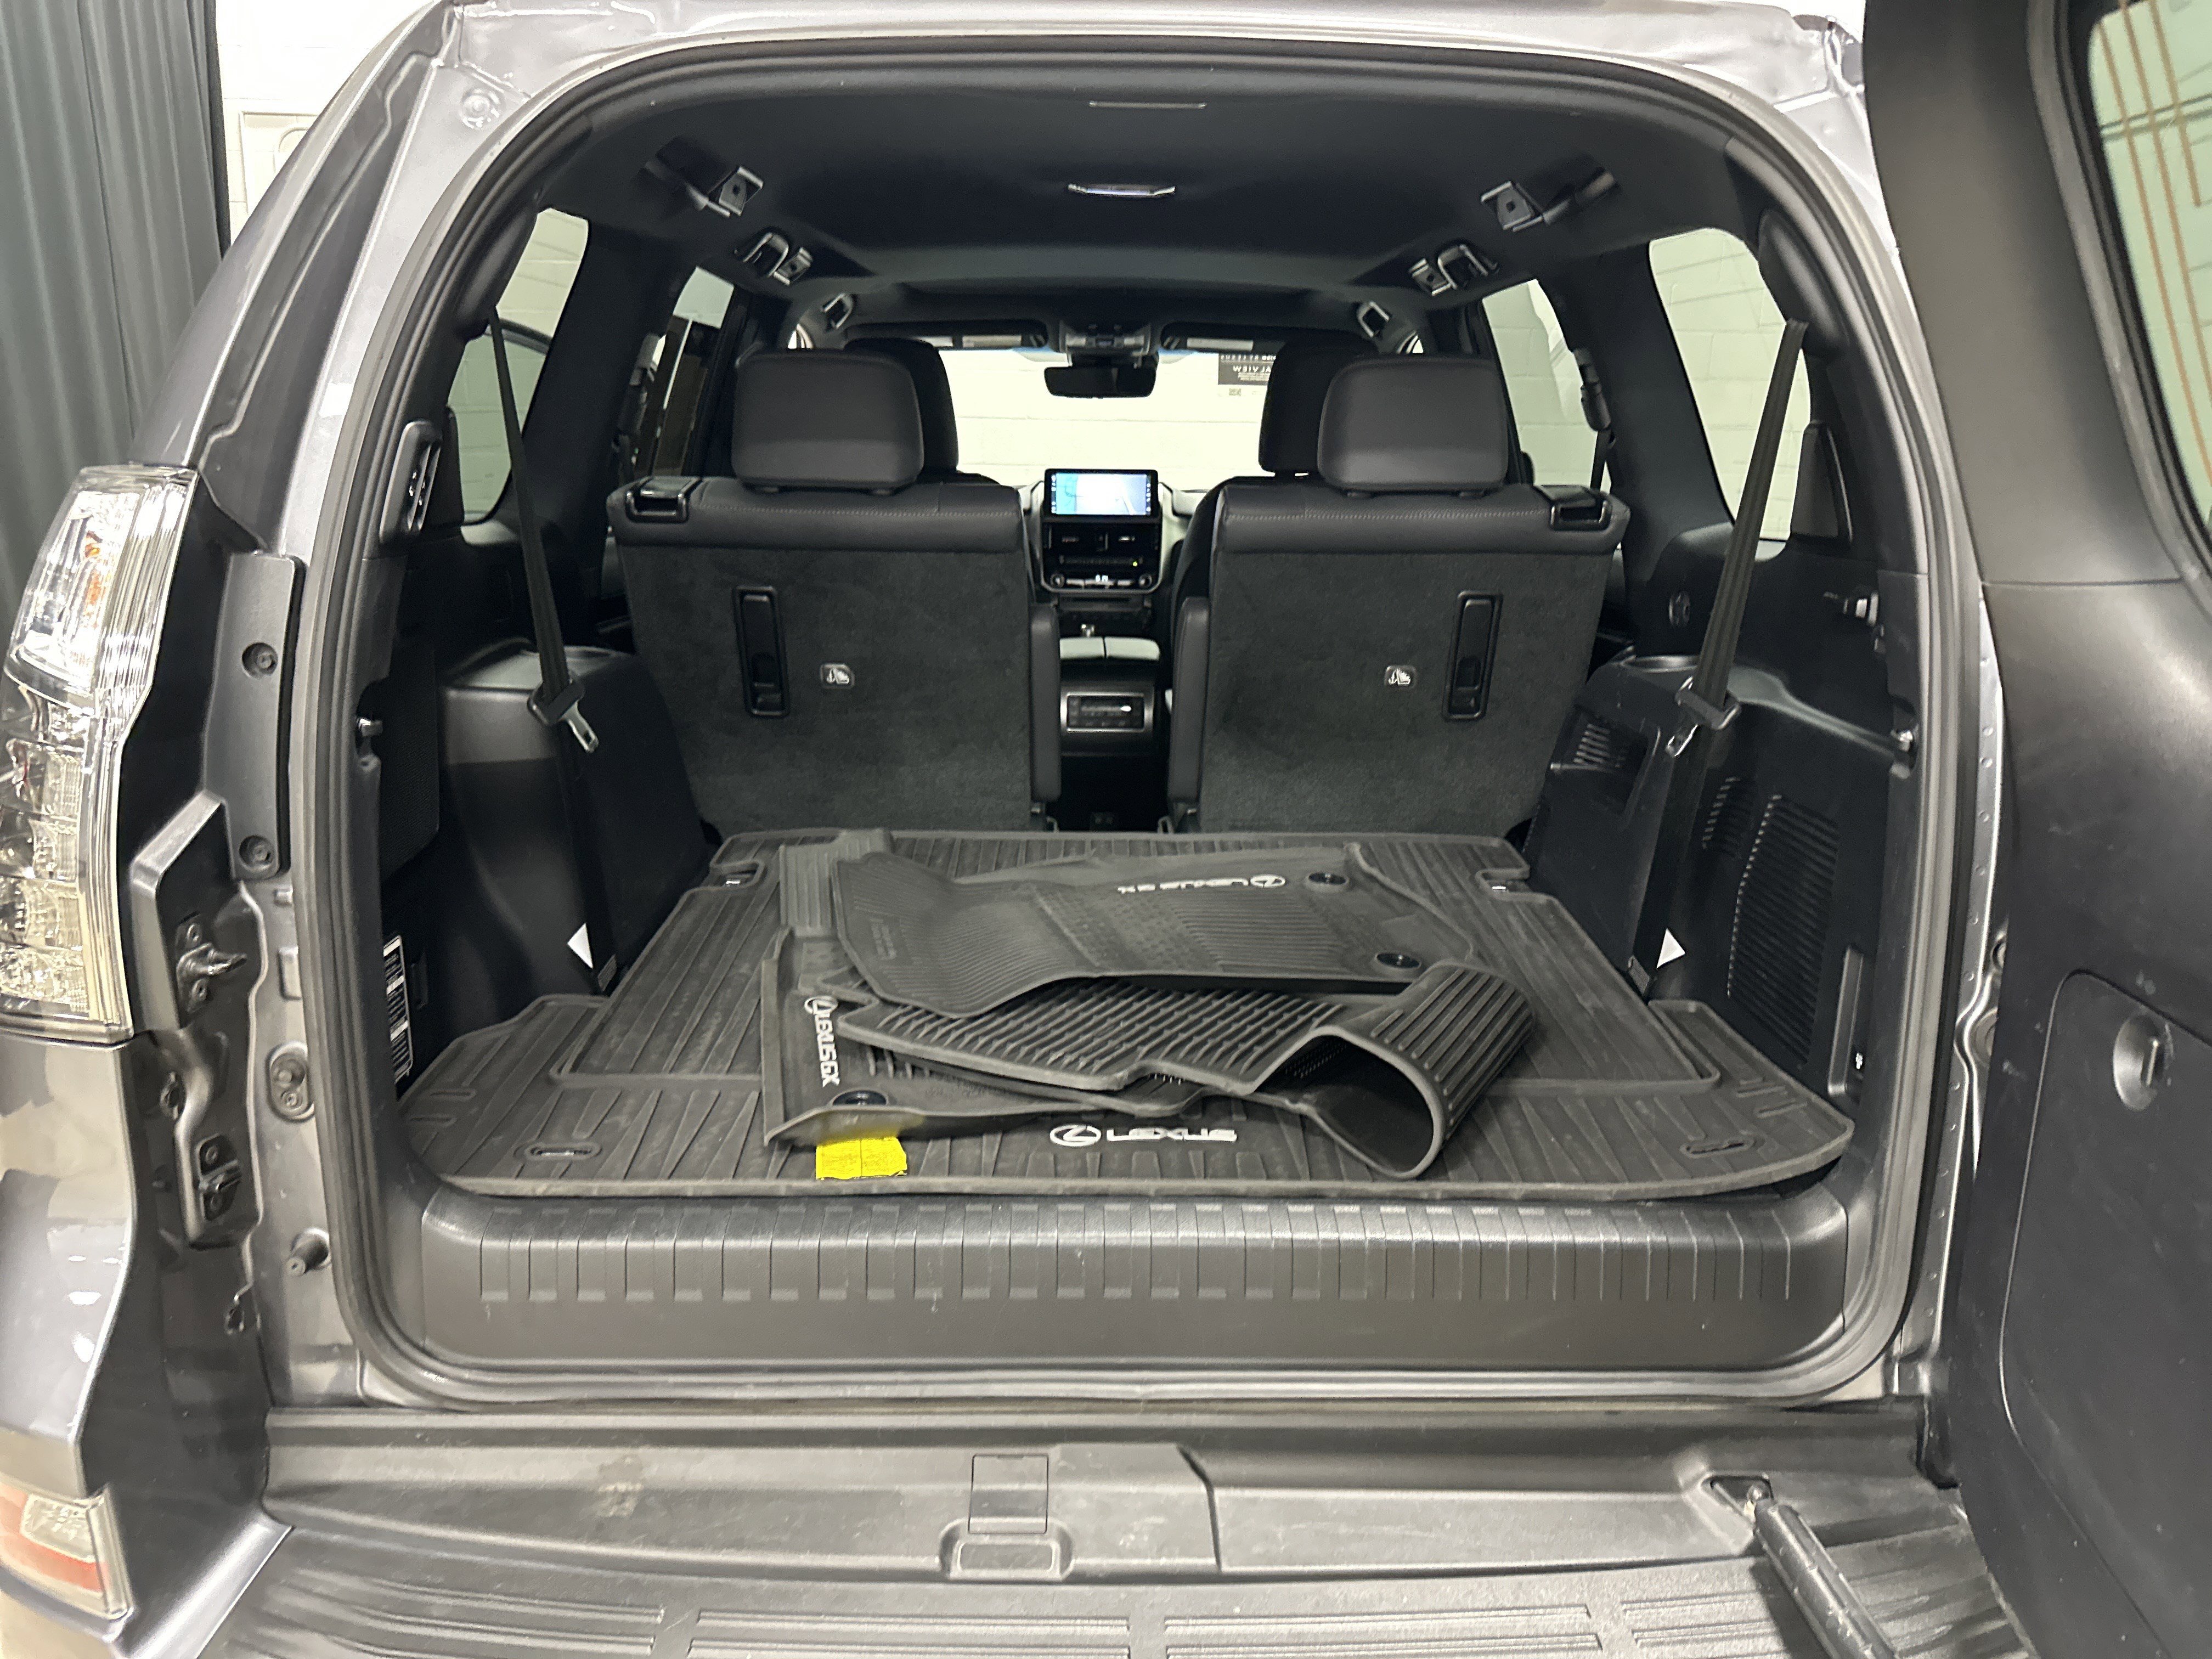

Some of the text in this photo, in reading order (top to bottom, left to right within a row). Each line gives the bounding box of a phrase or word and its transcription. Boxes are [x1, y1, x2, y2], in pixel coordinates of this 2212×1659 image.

[815, 1013, 840, 1088] LEXUS GX
[1107, 1127, 1238, 1143] LEXUS
